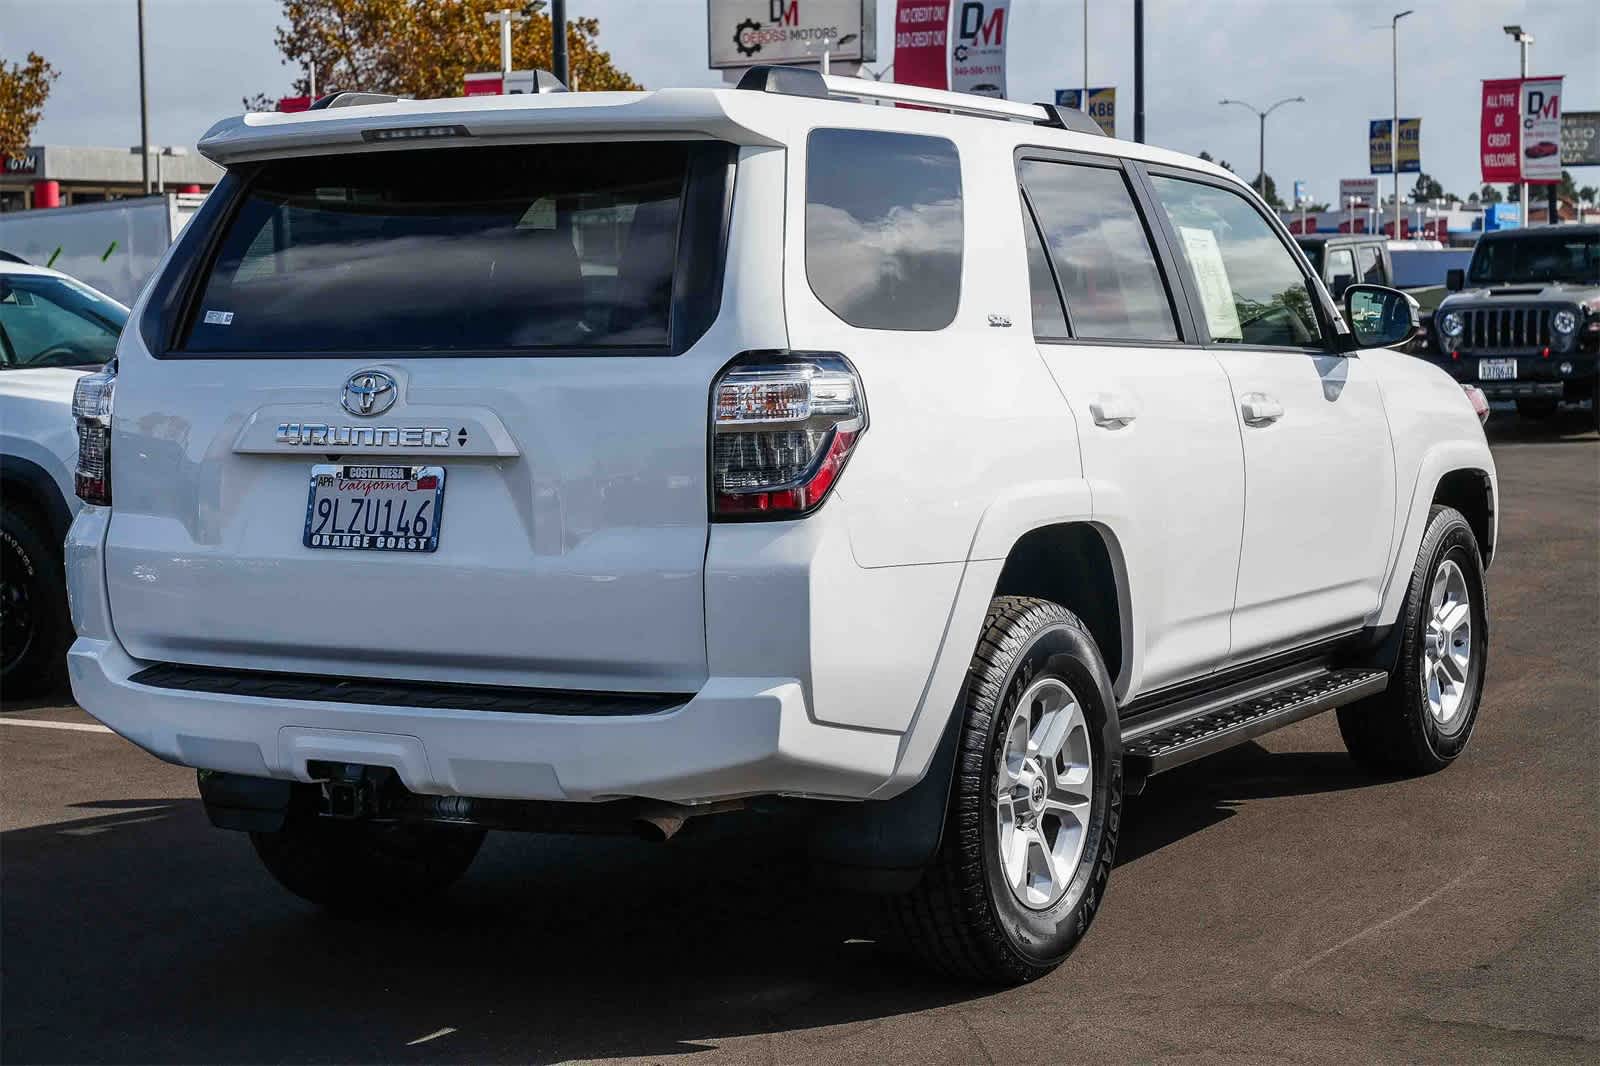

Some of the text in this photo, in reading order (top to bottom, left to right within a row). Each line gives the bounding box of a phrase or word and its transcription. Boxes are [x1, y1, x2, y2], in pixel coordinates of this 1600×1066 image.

[769, 0, 799, 27] DM
[900, 7, 910, 23] NO
[911, 7, 931, 22] CREDIT
[960, 2, 1005, 46] DM
[742, 26, 838, 45] DEBOSS MOTORS
[897, 33, 911, 48] BAD
[912, 32, 931, 48] CREDIT
[1486, 94, 1515, 107] ALL TYPE
[1527, 91, 1558, 119] DM
[1494, 113, 1504, 127] OF
[1487, 133, 1511, 147] CREDIT
[1484, 152, 1517, 167] WELCOME
[275, 423, 451, 447] 4RUNNER
[318, 476, 334, 487] APR
[350, 467, 404, 480] COSTA MESA
[338, 478, 418, 497] California
[314, 498, 431, 537] 9LZU146
[311, 535, 428, 550] ORANGE COAST
